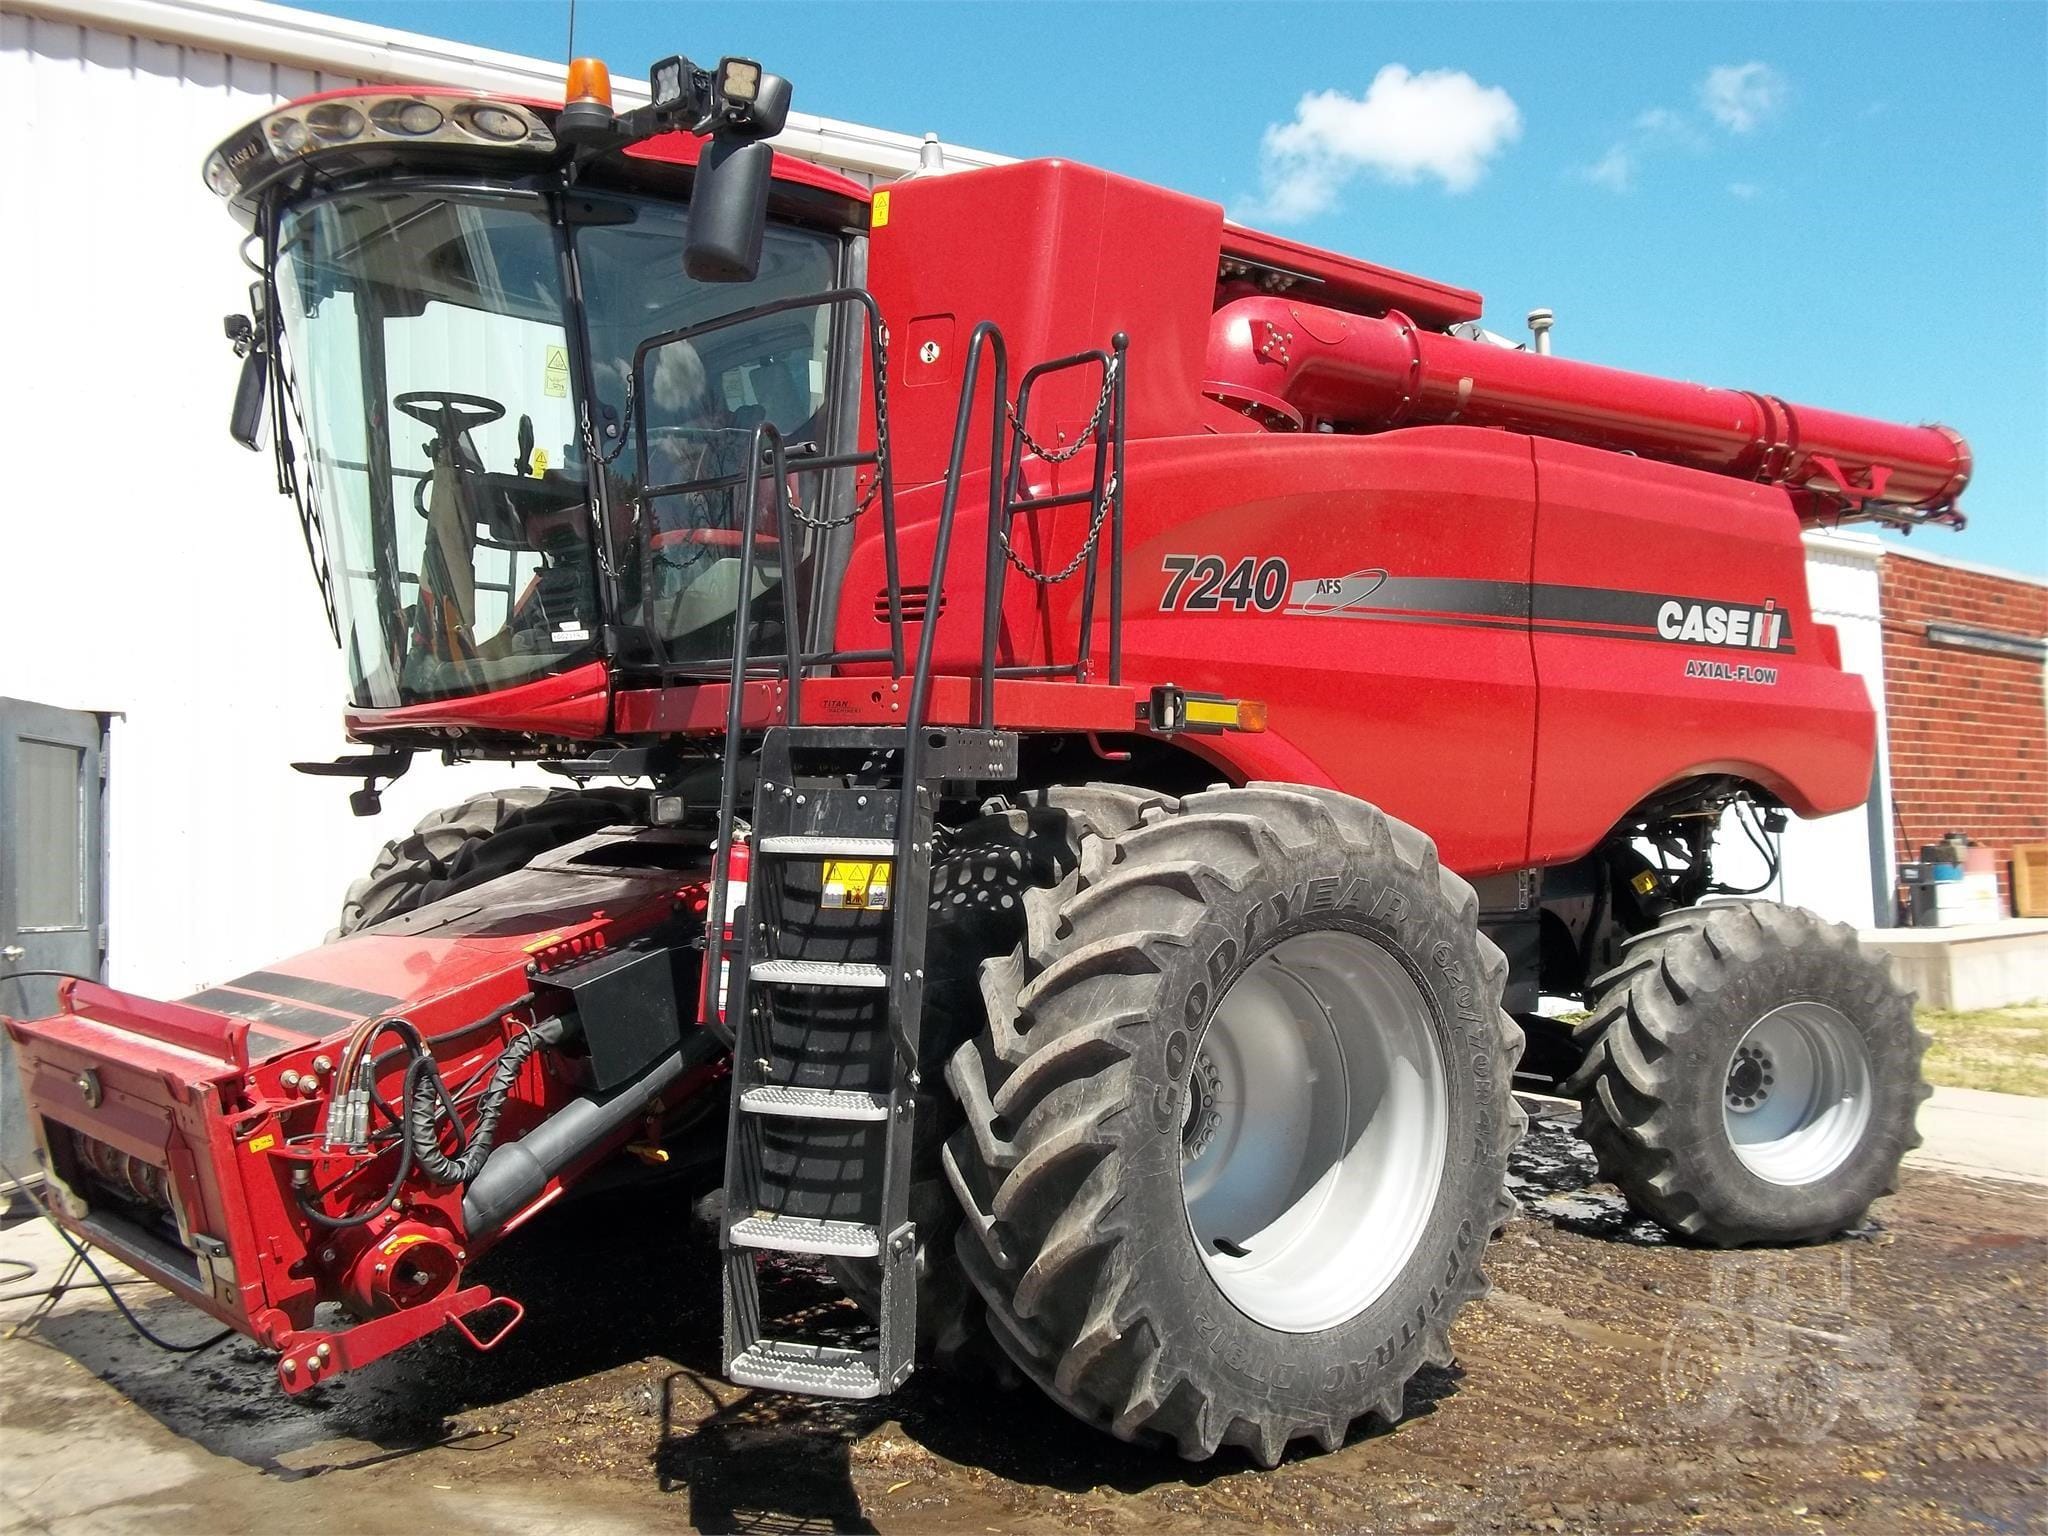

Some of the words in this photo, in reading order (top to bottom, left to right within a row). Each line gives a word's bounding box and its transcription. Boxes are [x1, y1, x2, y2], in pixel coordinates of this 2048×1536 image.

[1159, 554, 1289, 612] 7240
[1316, 578, 1342, 595] AFS
[1657, 600, 1750, 646] CASE
[1685, 660, 1777, 685] AXIAL-FLOW
[823, 700, 849, 708] TITAN
[1153, 876, 1411, 1134] GOODYEAR
[1322, 1218, 1472, 1392] OPTITRAC
